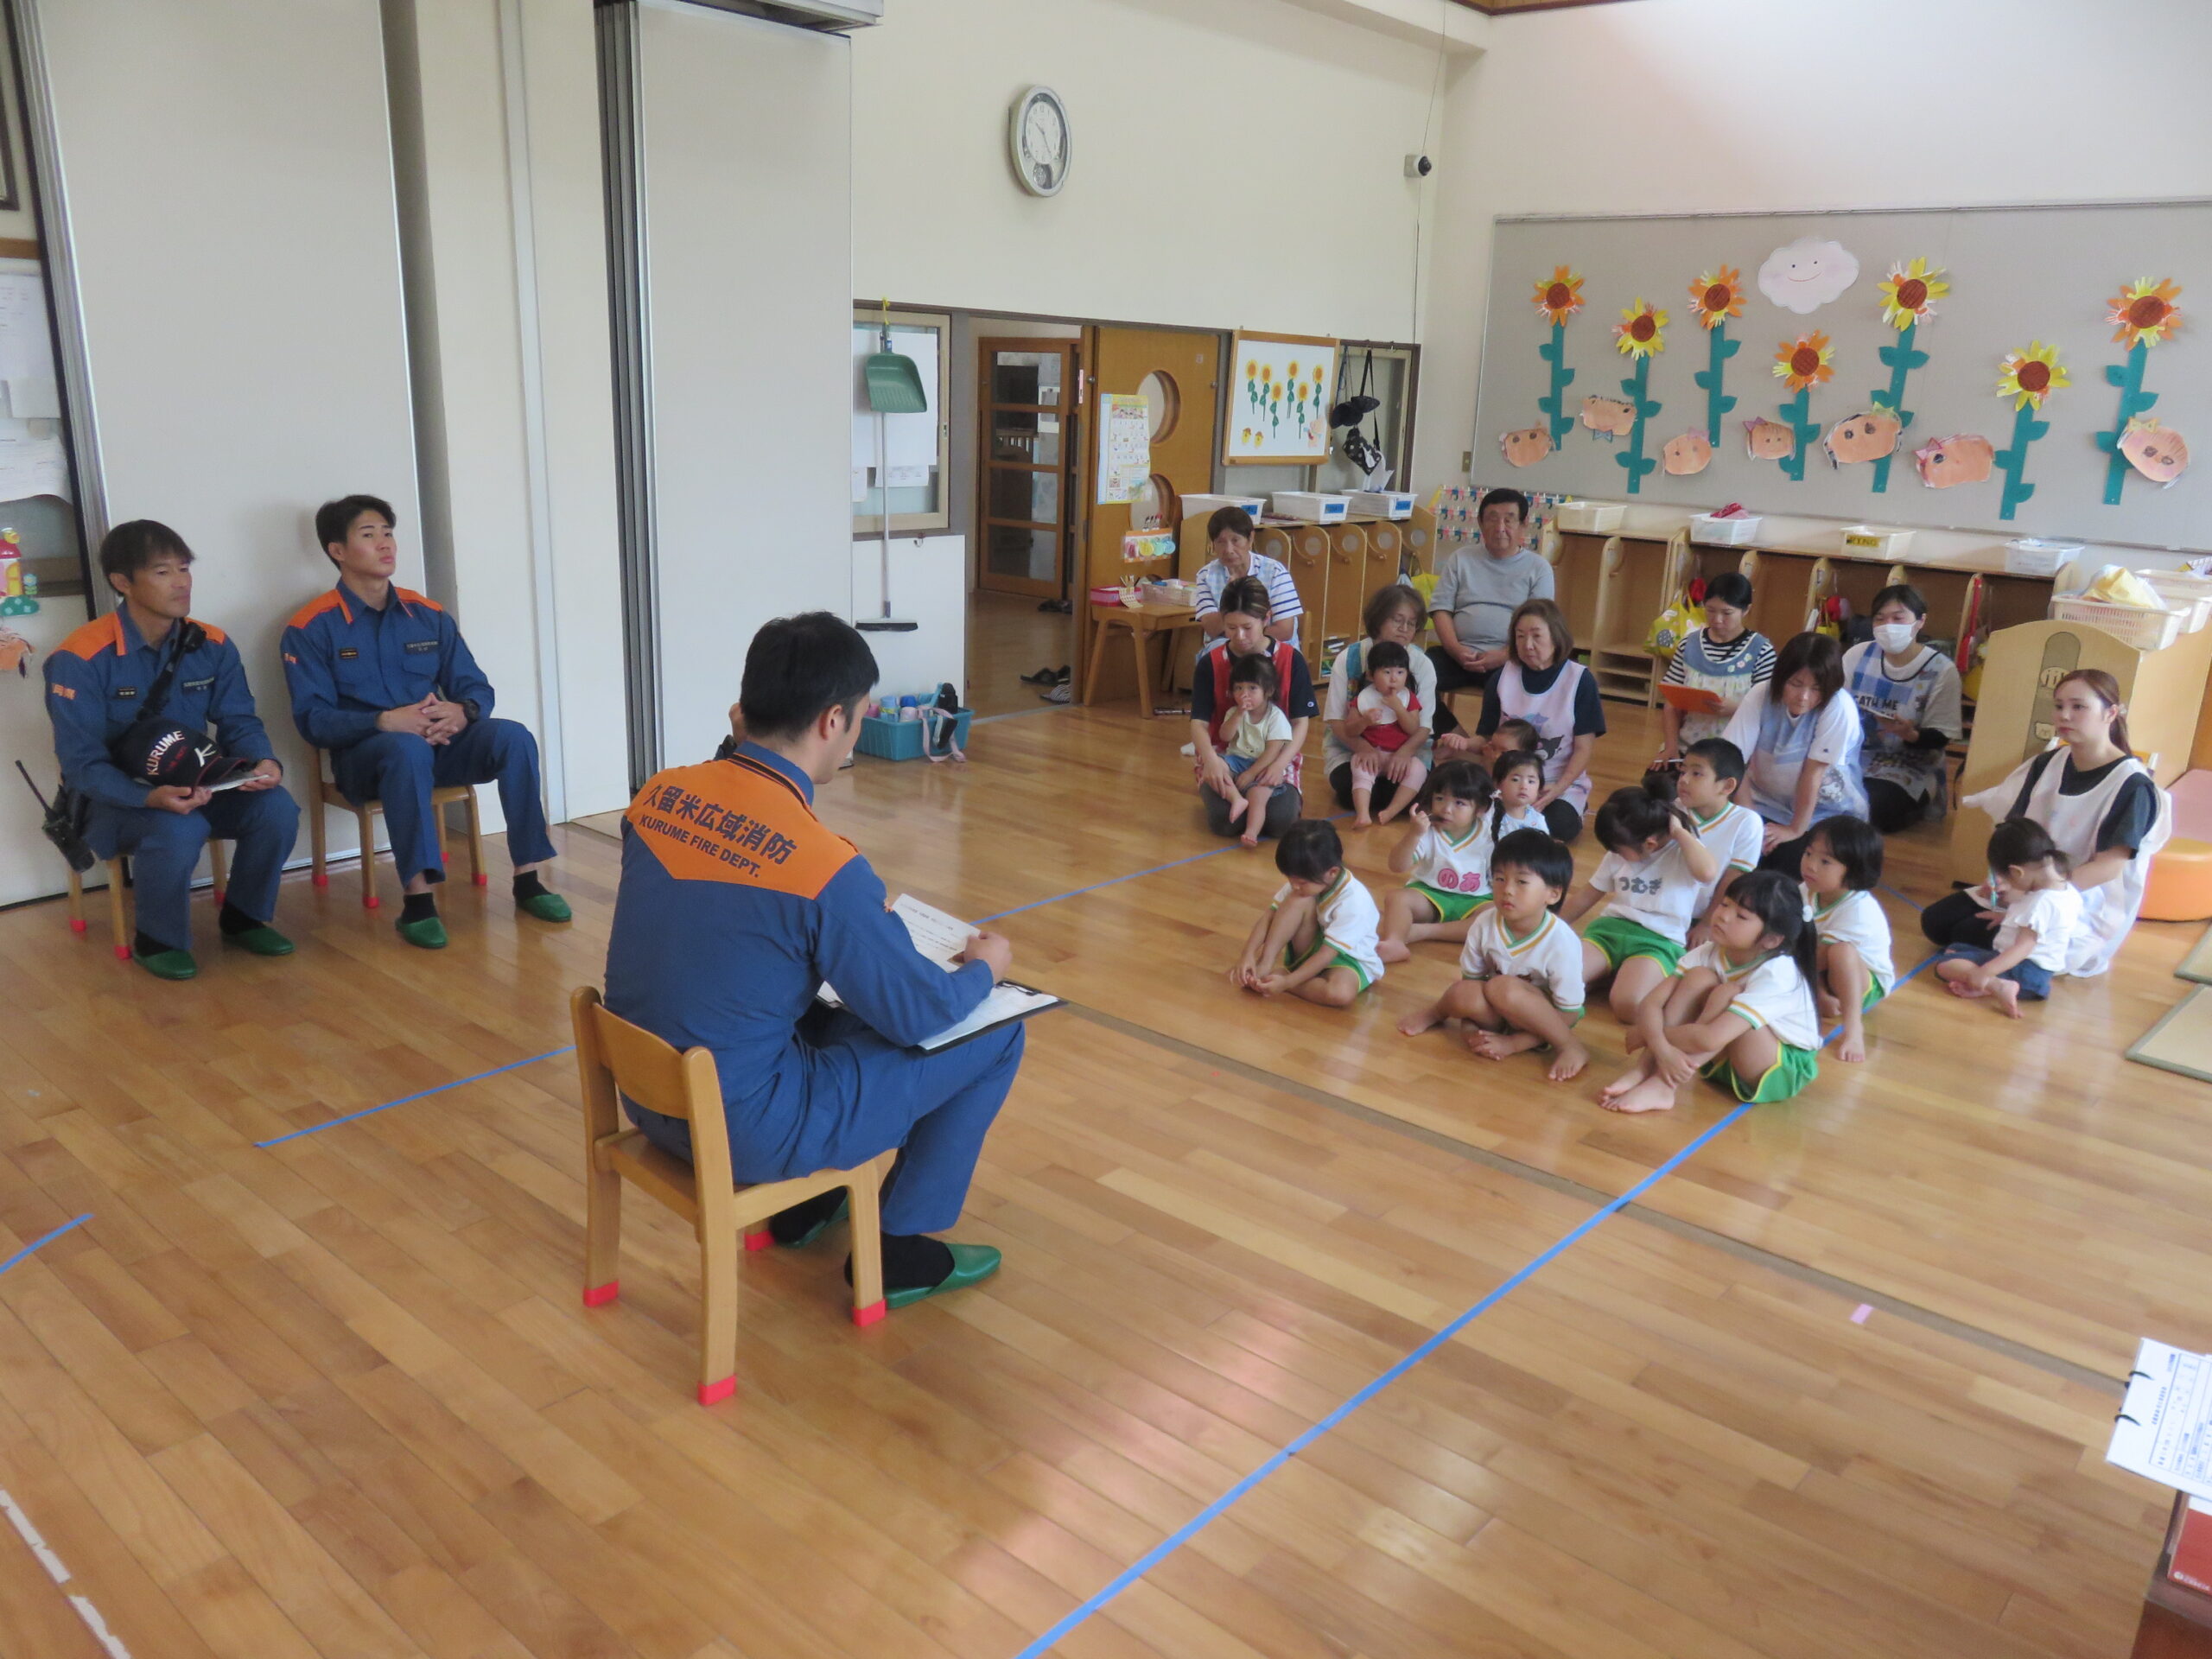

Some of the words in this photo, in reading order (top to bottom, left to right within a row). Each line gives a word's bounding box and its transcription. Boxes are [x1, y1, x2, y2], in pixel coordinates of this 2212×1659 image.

[145, 730, 186, 775] KURUME
[194, 743, 217, 767] K
[643, 783, 798, 865] 久留米広域消防
[639, 814, 691, 843] KURUME
[690, 835, 721, 857] FIRE
[719, 848, 761, 878] DEPT.
[1437, 868, 1481, 893] のあ
[1618, 876, 1663, 895] つむぎ
